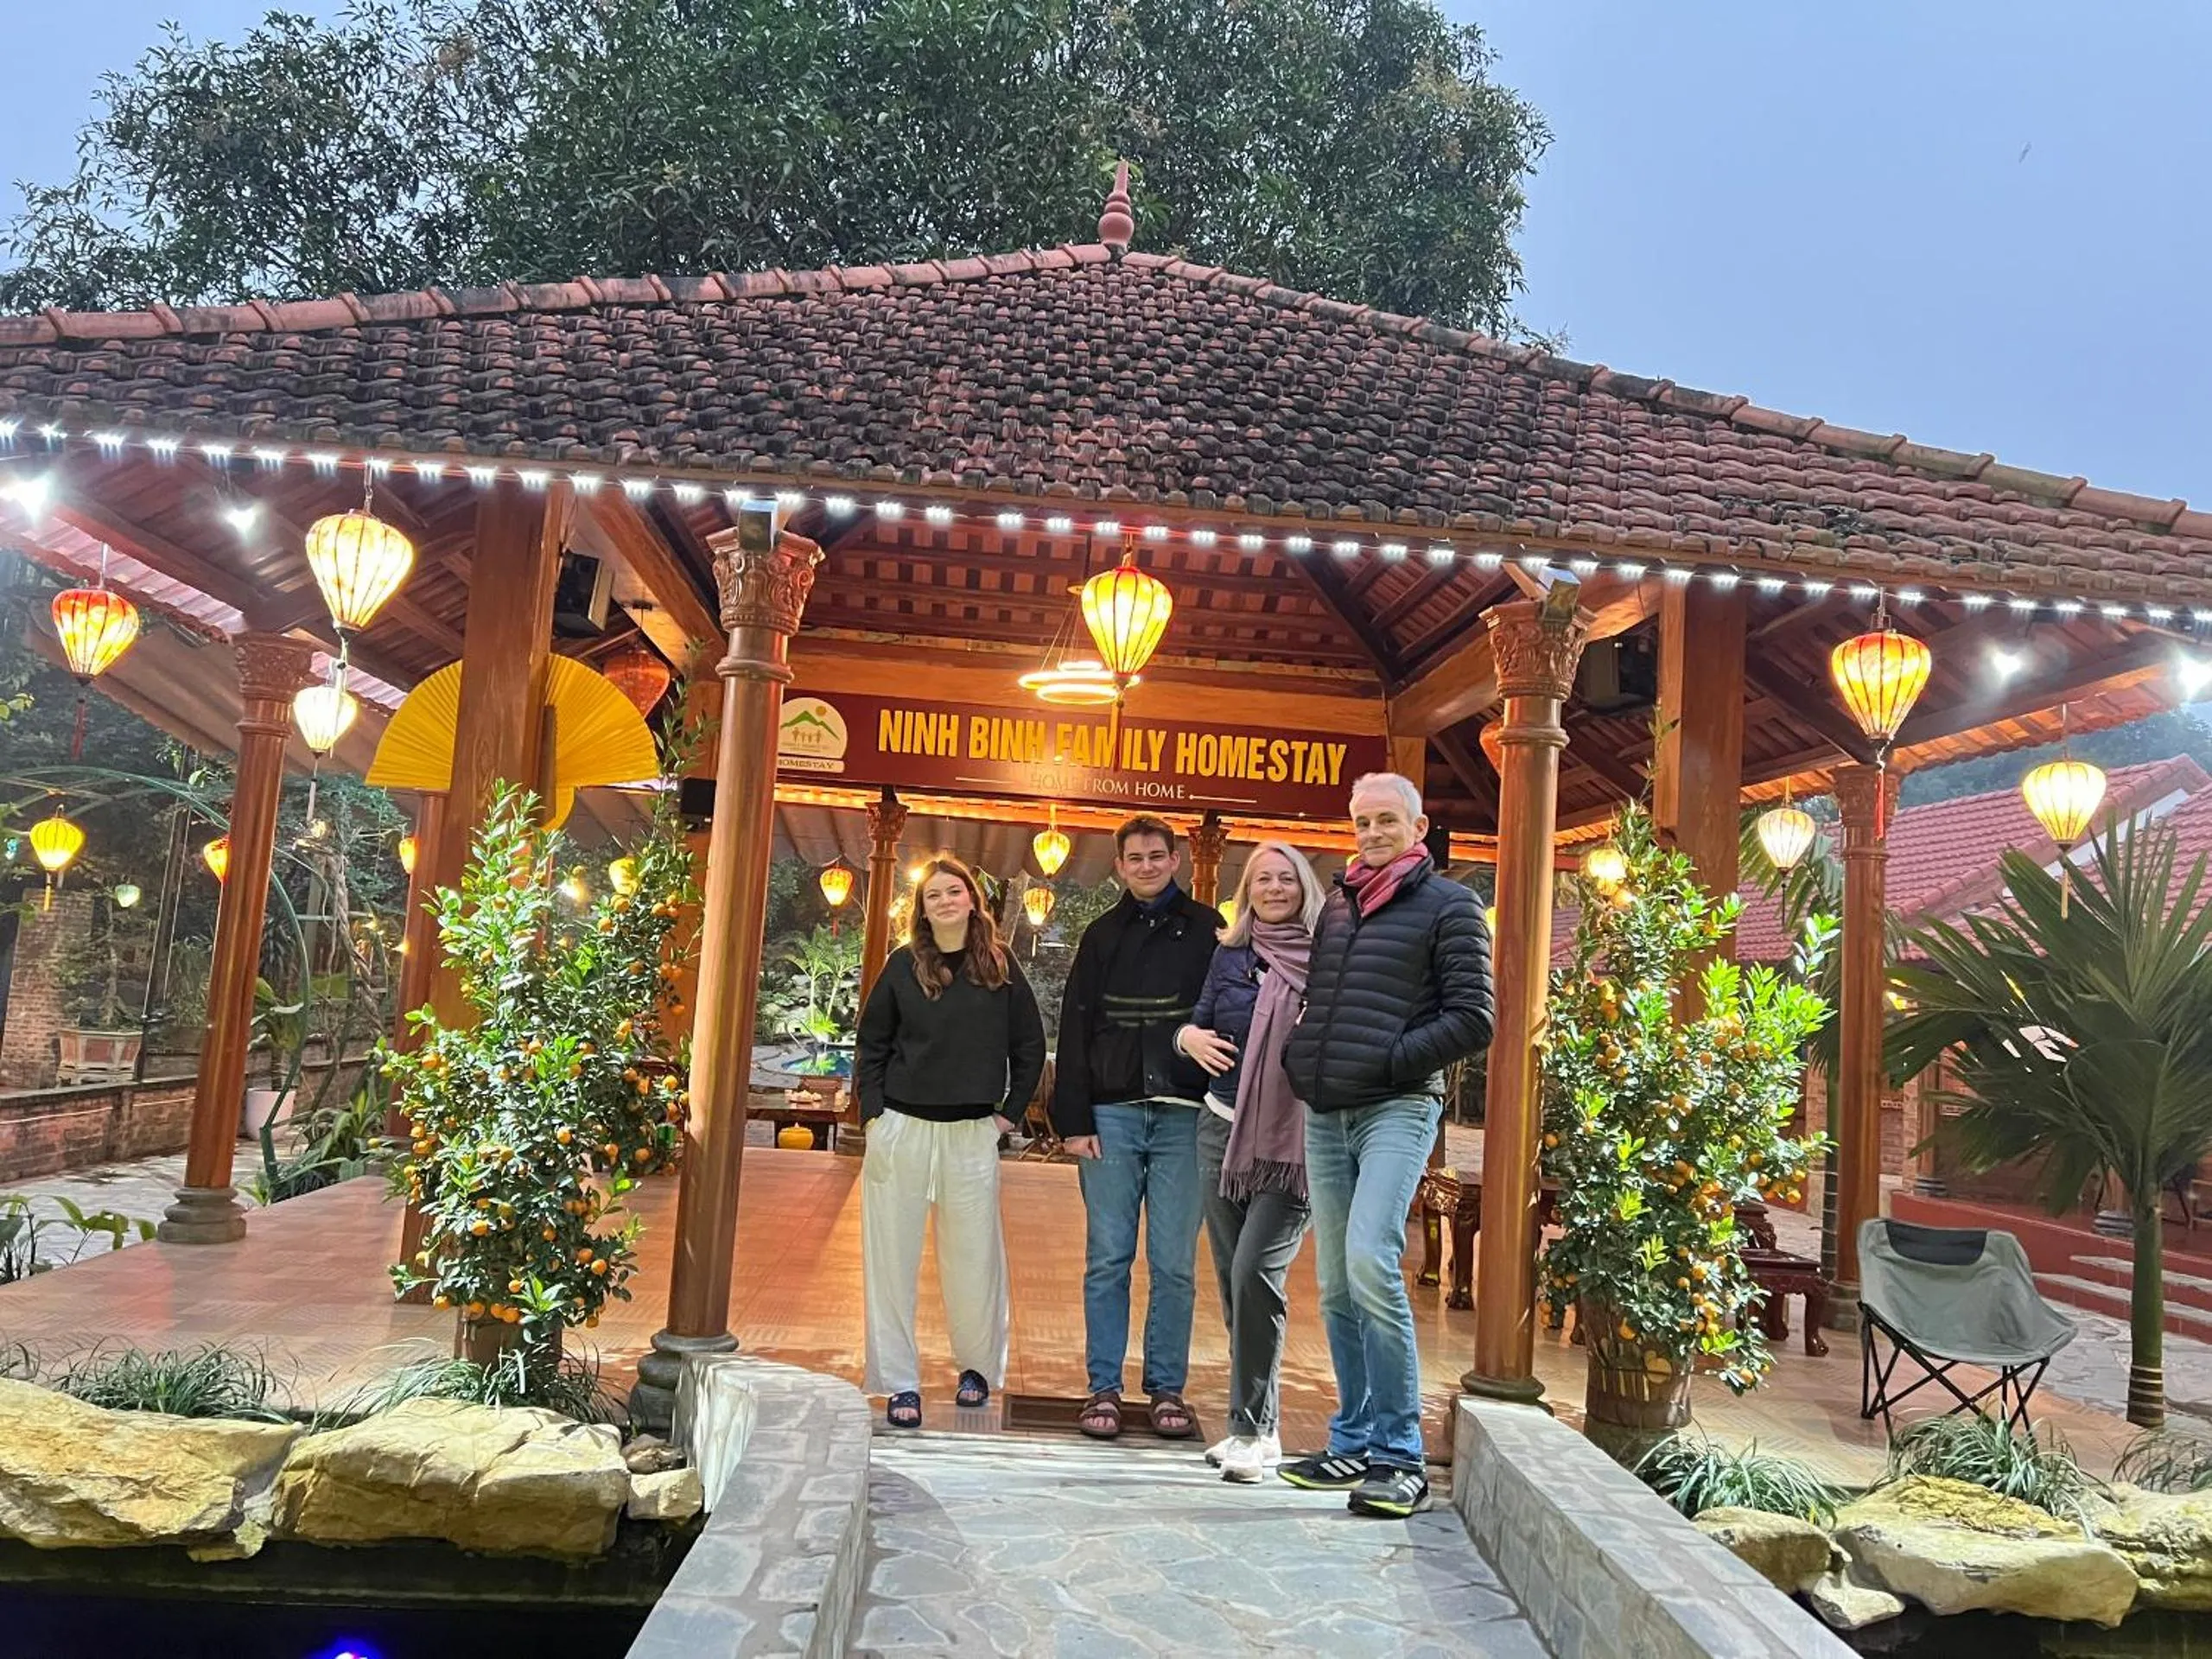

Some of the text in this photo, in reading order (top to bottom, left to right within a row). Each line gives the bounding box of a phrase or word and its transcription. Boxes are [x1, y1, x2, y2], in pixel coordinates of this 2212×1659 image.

[878, 709, 1347, 785] NINH BINH FAMILY HOMESTAY
[1083, 778, 1129, 795] FROM
[1135, 780, 1185, 799] HOME
